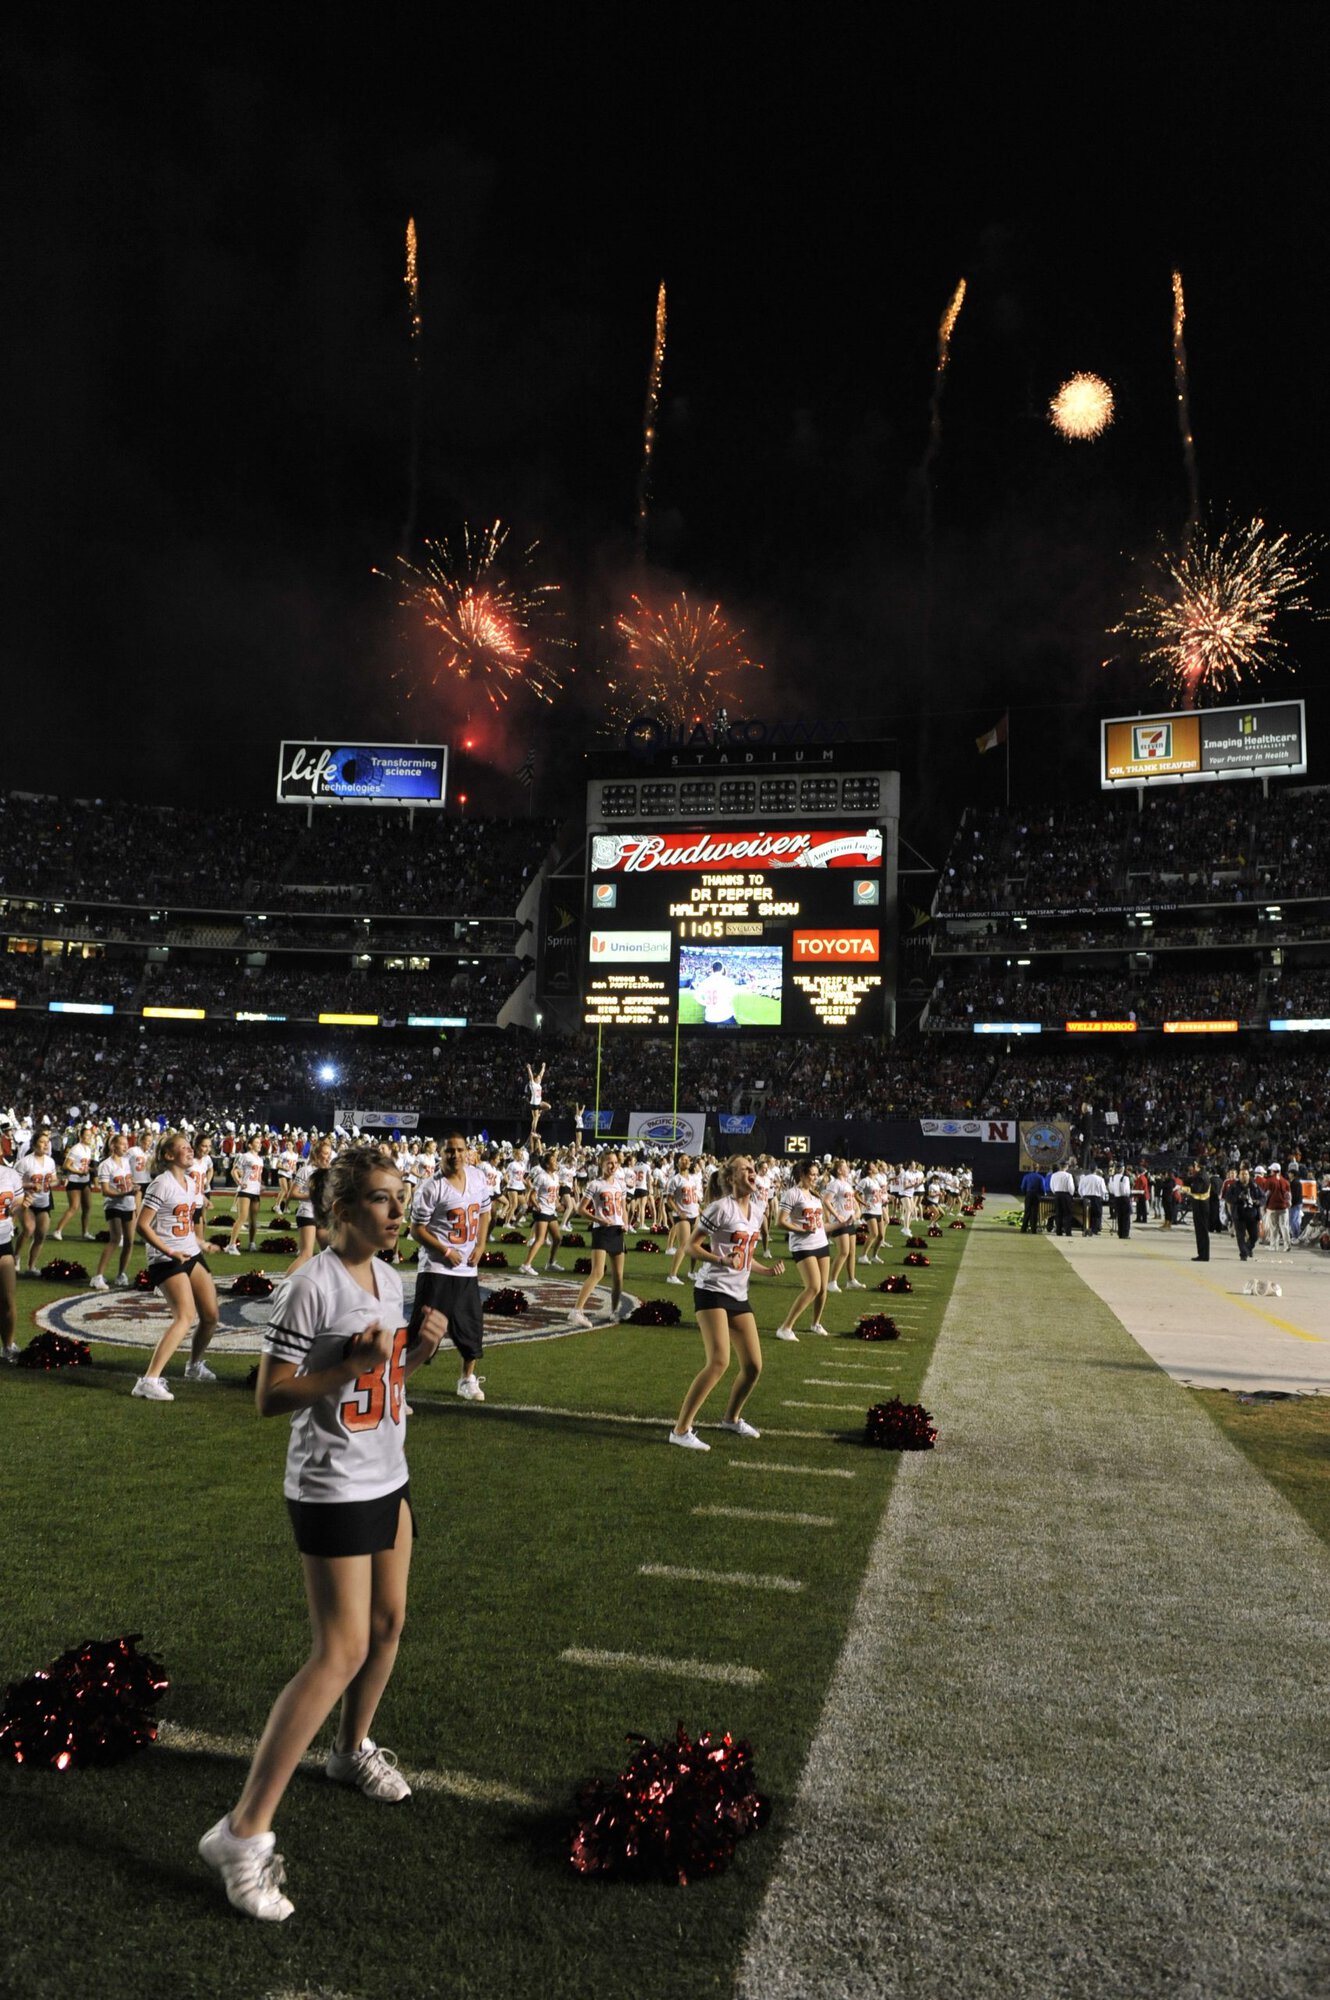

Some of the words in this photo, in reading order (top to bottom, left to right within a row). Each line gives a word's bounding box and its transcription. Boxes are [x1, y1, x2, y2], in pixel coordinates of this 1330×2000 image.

[625, 718, 849, 761] QUACOMM
[1204, 738, 1242, 750] Imaging
[1244, 733, 1297, 746] Healthcare
[372, 758, 438, 770] Transforming
[671, 750, 834, 765] STADIUM
[1209, 756, 1225, 764] Your
[1227, 754, 1253, 763] Partner
[1264, 751, 1289, 760] Health
[282, 748, 338, 794] life
[385, 767, 422, 776] science
[1109, 766, 1124, 775] OH,
[1126, 764, 1158, 774] THANK
[1160, 760, 1197, 771] HEAVEN!
[321, 782, 382, 793] technologies
[617, 832, 811, 872] Budweiser
[812, 844, 852, 862] American
[702, 874, 744, 886] THANKS
[748, 874, 764, 886] TO
[690, 888, 712, 901] DR
[717, 887, 773, 901] PEPPER
[670, 903, 749, 916] HALFTIME
[758, 902, 800, 916] SHOW
[680, 922, 724, 938] 11:05
[610, 942, 669, 952] UnionBank
[798, 938, 876, 954] TOYOTA
[1068, 1022, 1100, 1031] WELLS
[1101, 1022, 1136, 1031] FARGO
[988, 1122, 1008, 1141] N
[788, 1136, 806, 1152] 25
[446, 1203, 481, 1245] 36
[802, 1208, 823, 1233] 36
[340, 1327, 408, 1434] 36
